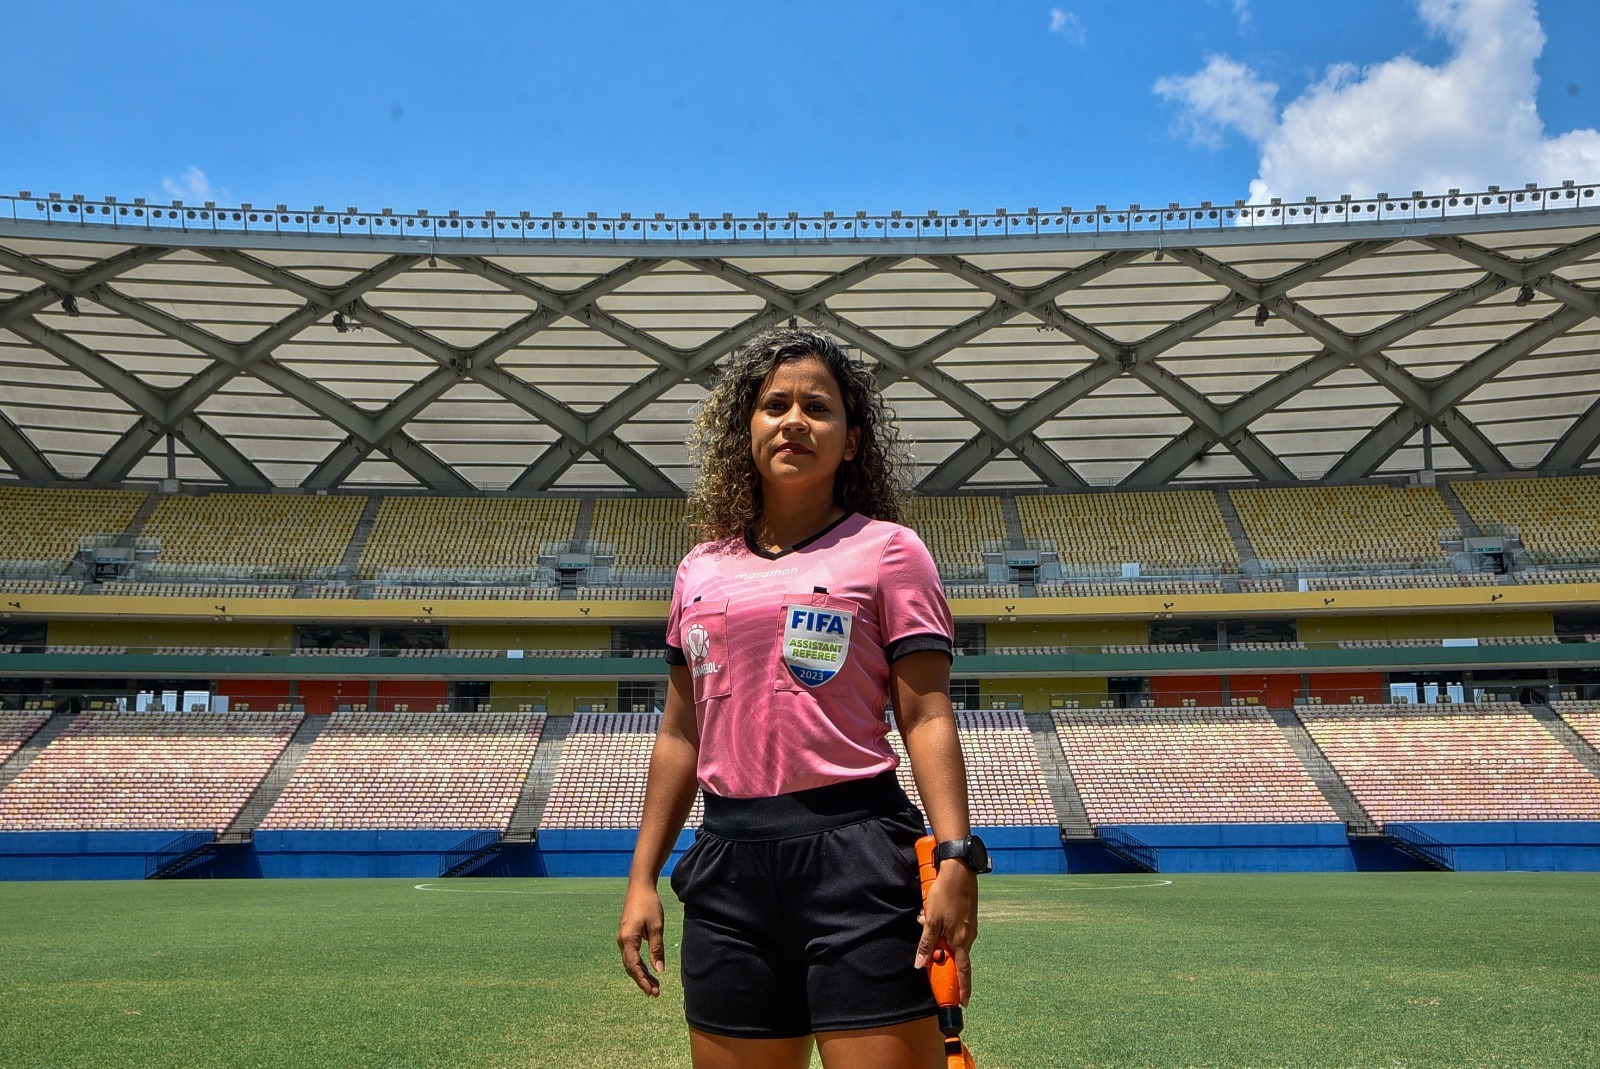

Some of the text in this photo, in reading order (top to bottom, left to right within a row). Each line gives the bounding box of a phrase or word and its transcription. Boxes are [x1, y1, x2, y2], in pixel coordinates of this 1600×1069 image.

[735, 567, 799, 581] marathon
[791, 610, 845, 635] FIFA
[789, 639, 843, 654] ASSISTANT
[792, 648, 838, 662] REFEREE
[800, 669, 825, 681] 2023
